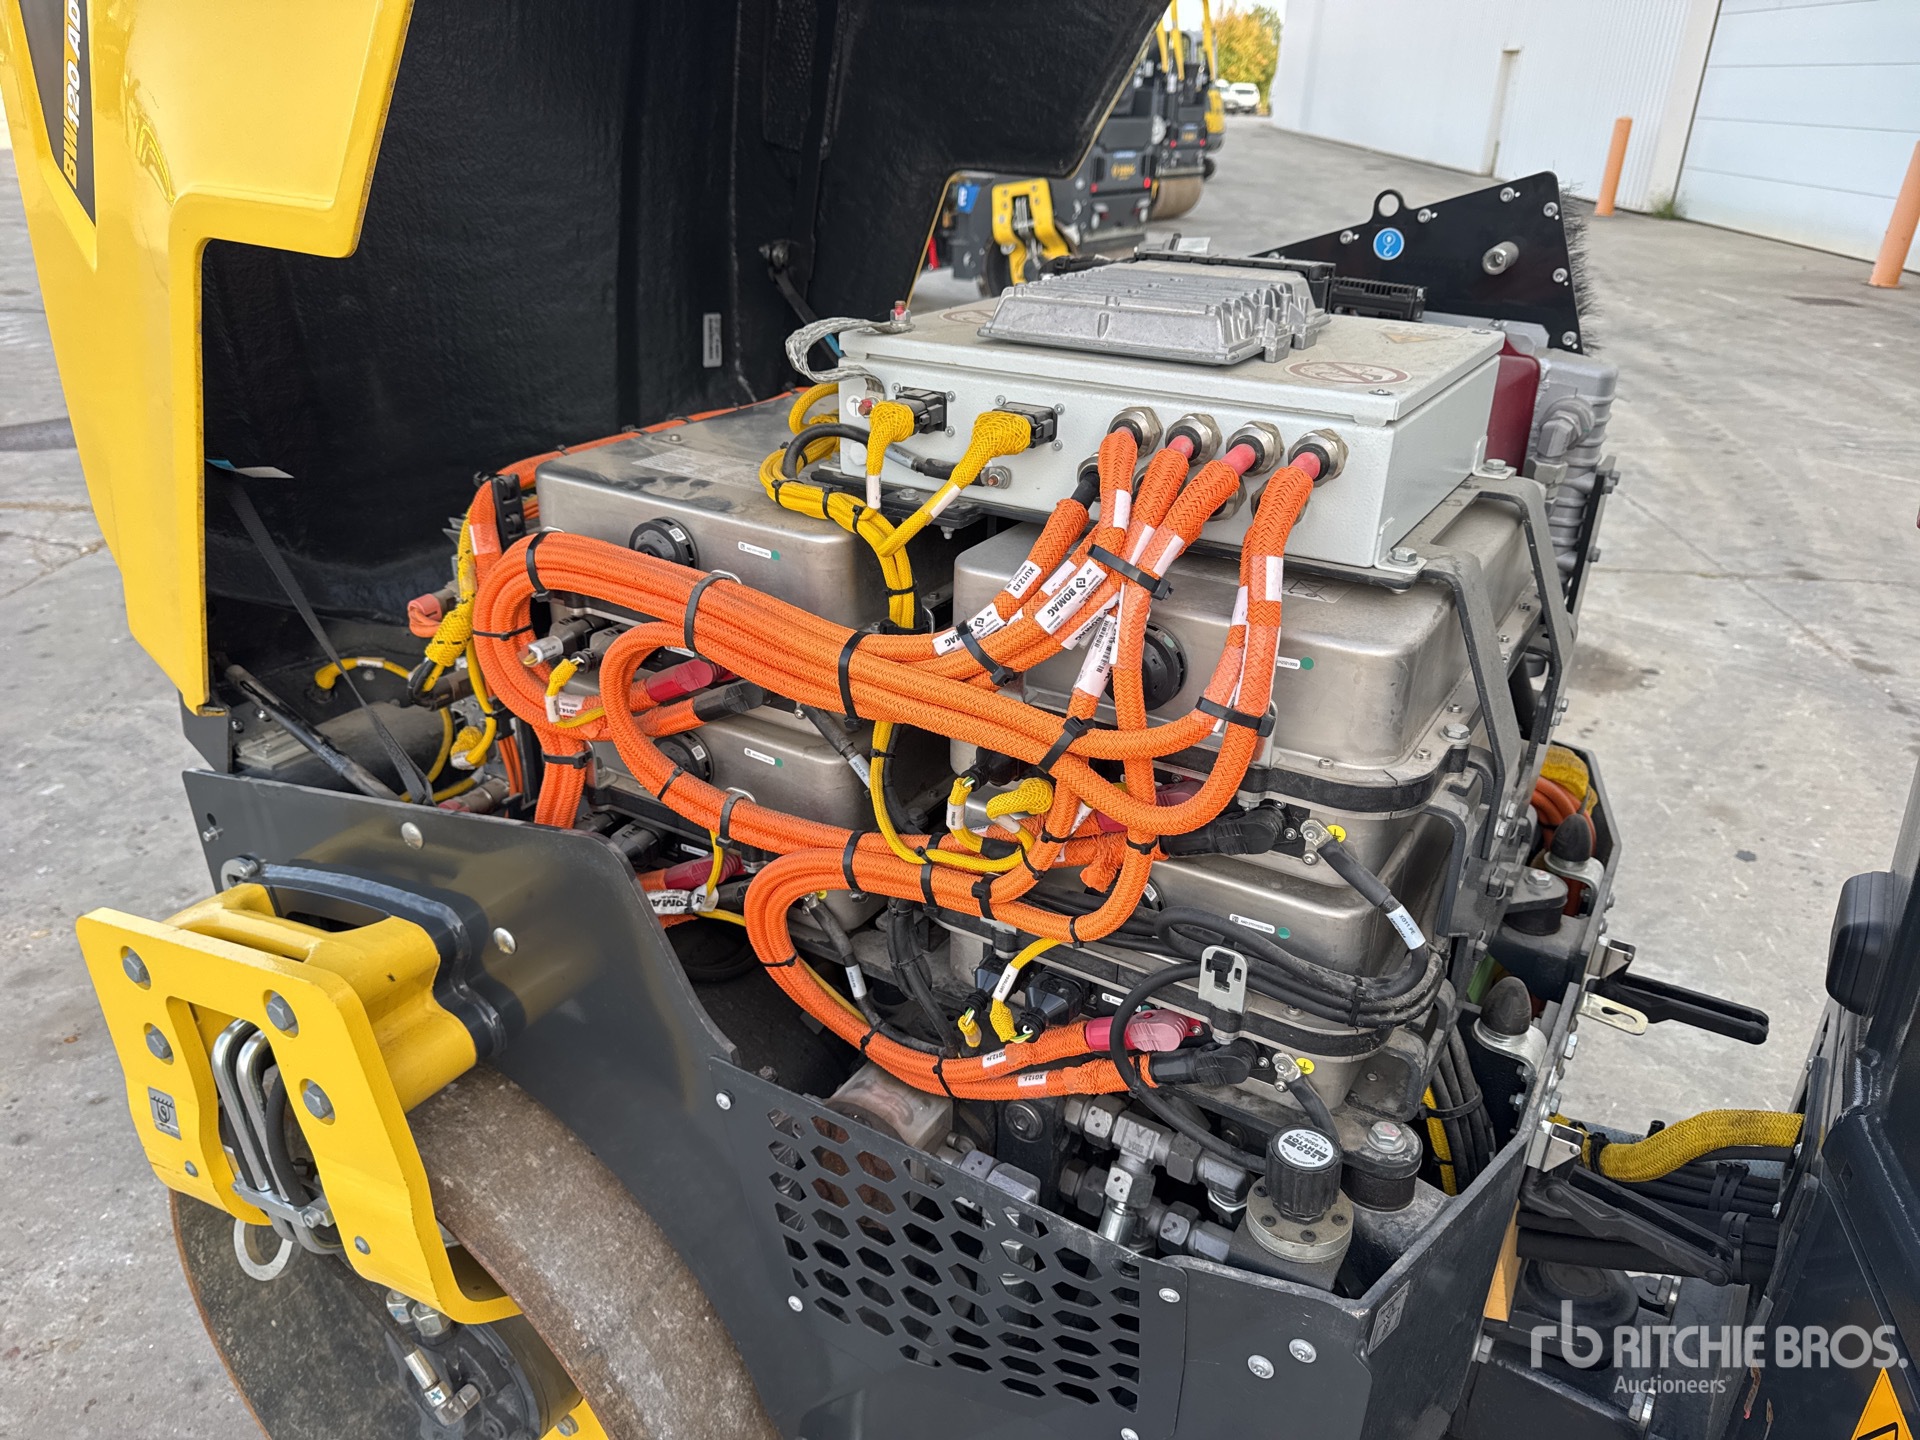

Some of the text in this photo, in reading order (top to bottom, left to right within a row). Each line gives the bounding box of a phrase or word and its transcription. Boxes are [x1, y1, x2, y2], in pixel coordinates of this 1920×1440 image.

[1047, 587, 1077, 617] BOMAG
[1286, 1135, 1315, 1152] HYTOS
[1296, 1146, 1325, 1162] ARGO
